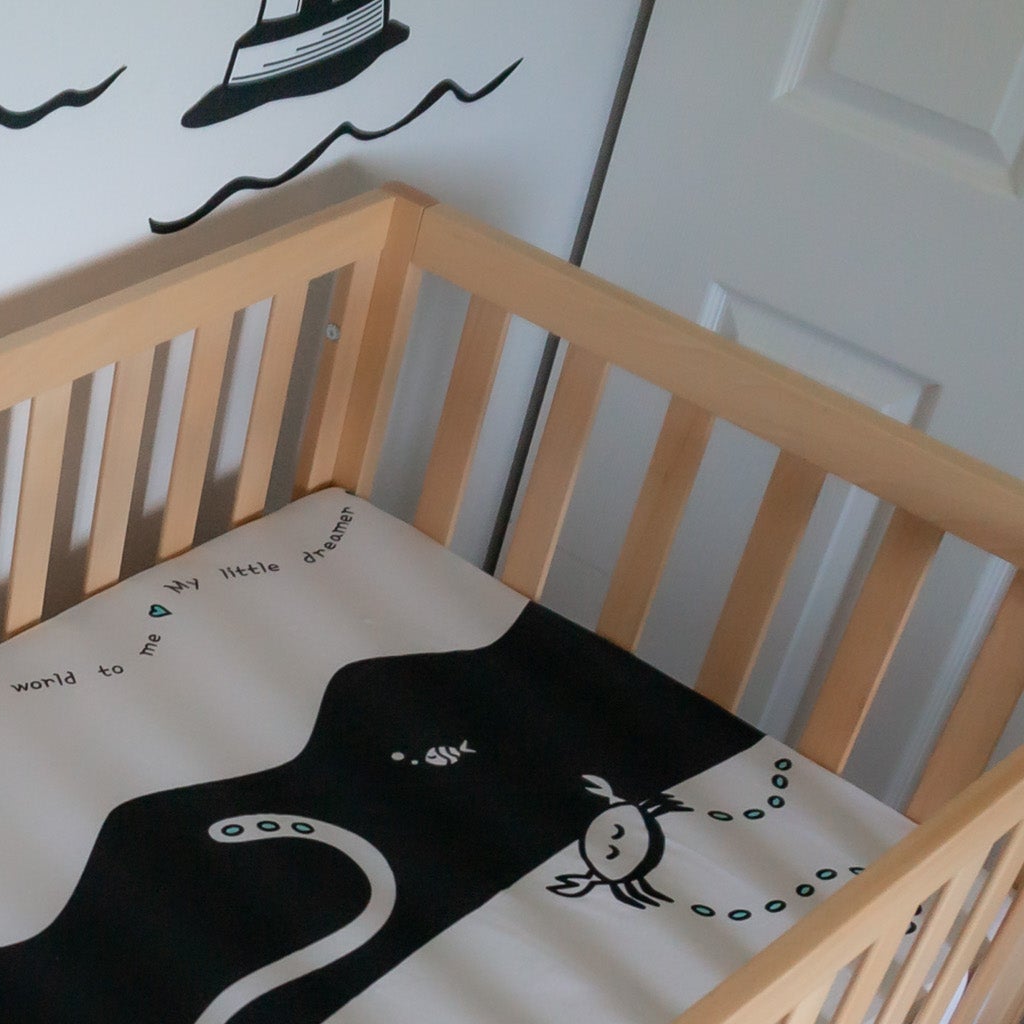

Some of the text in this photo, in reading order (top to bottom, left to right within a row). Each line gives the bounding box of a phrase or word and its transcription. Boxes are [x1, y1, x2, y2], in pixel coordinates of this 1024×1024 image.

[10, 670, 77, 693] world
[97, 664, 124, 677] to
[139, 633, 162, 657] me
[163, 577, 200, 594] My
[219, 561, 280, 580] little
[302, 506, 354, 564] dreamer
